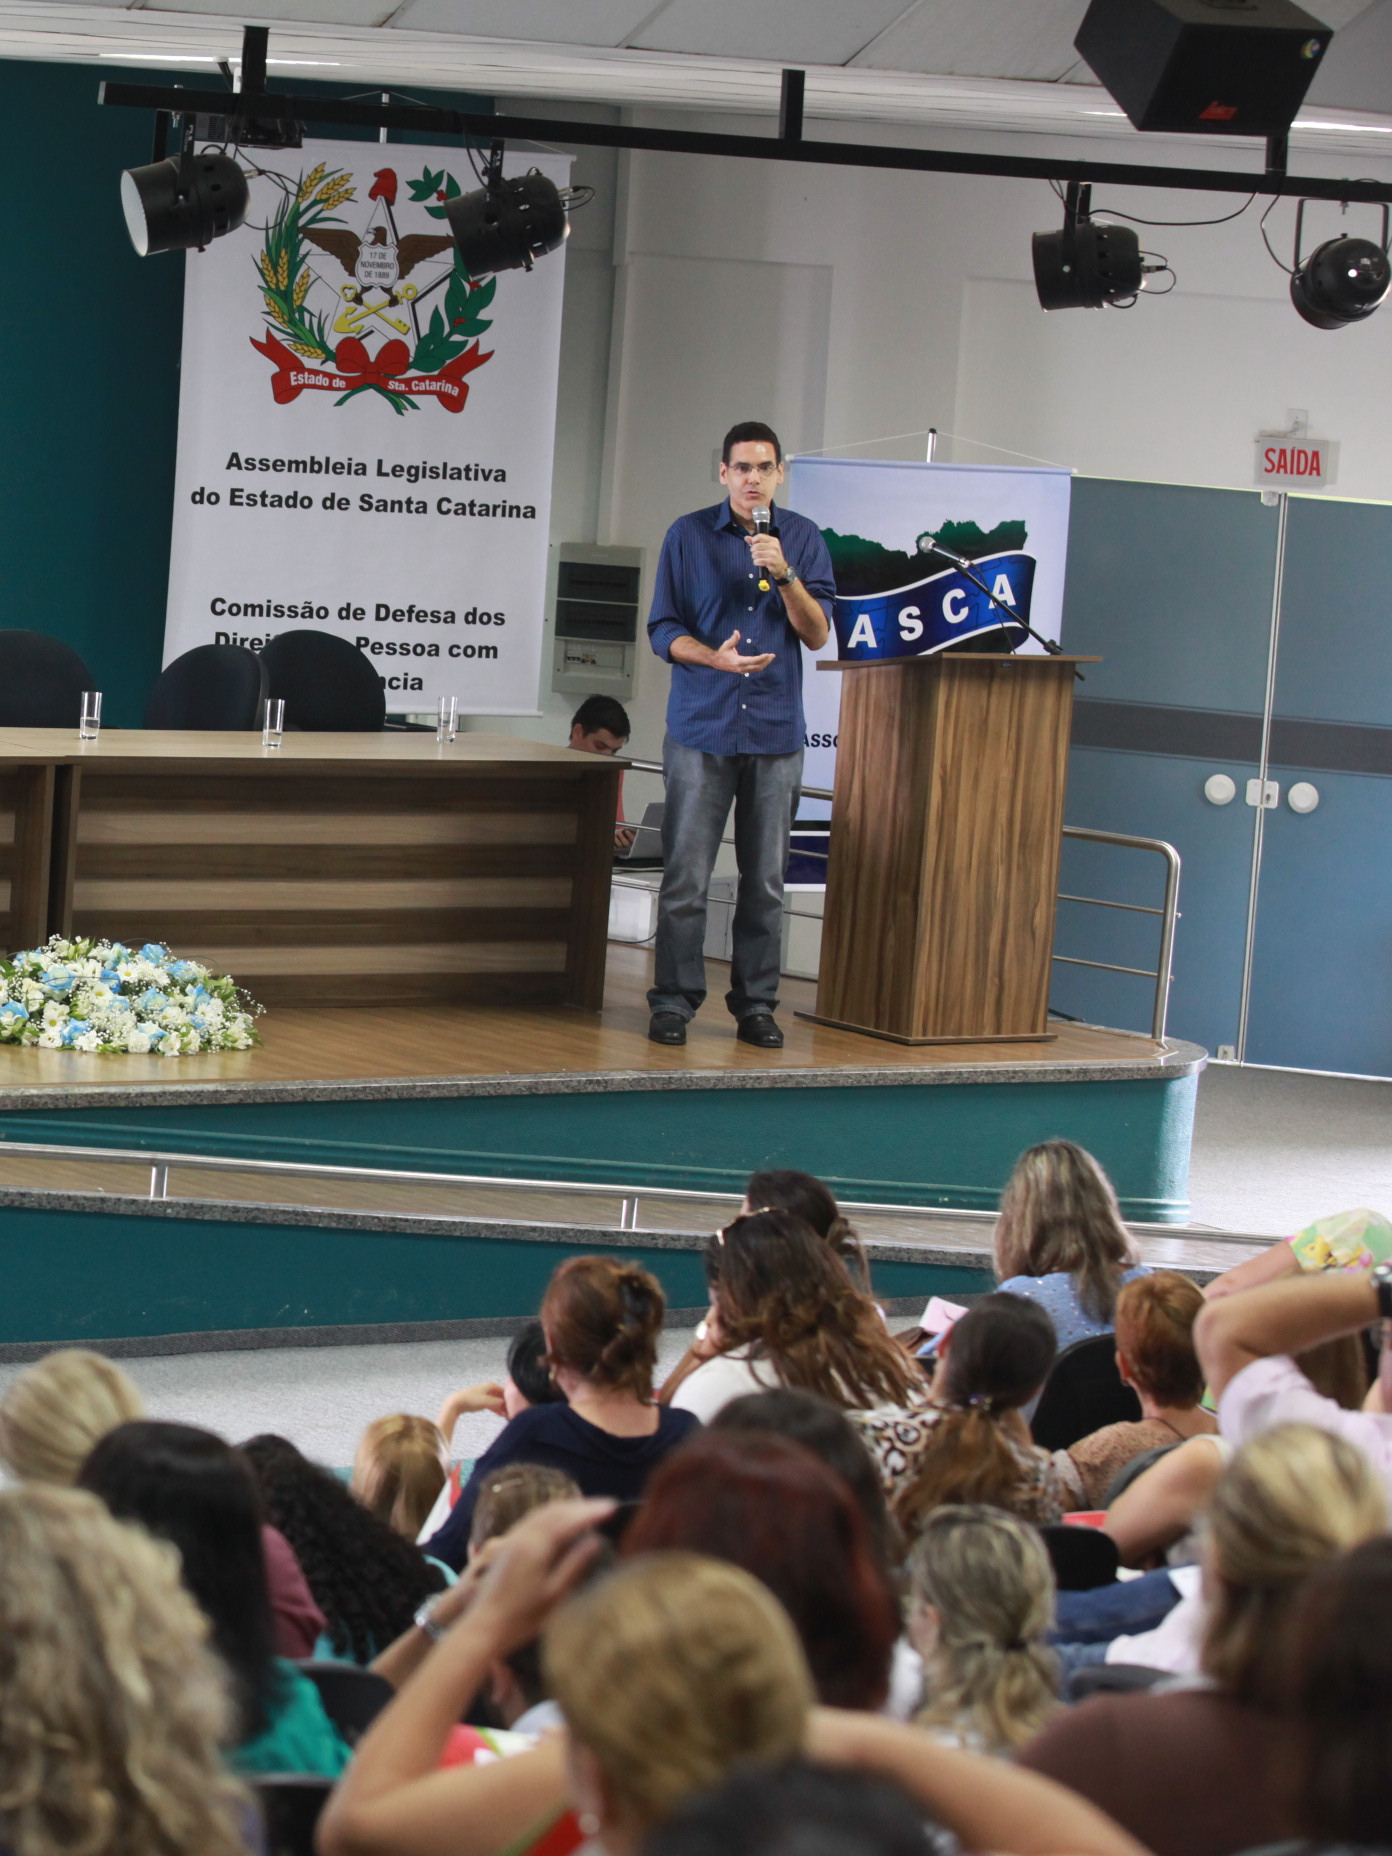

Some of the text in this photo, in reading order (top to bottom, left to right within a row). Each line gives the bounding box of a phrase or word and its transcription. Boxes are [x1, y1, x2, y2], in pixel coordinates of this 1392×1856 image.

[360, 261, 395, 270] NOVEMBRO
[369, 251, 387, 260] 17 DE
[364, 270, 390, 279] DE 1889
[290, 371, 460, 397] Estado de Sta. Catarina
[225, 451, 507, 484] Assembleia Legislativa
[1263, 446, 1322, 477] SAÍDA
[190, 486, 537, 520] do Estado de Santa Catarina
[210, 597, 506, 626] Comissão de Defesa dos
[214, 631, 499, 659] Direi Pessoa com
